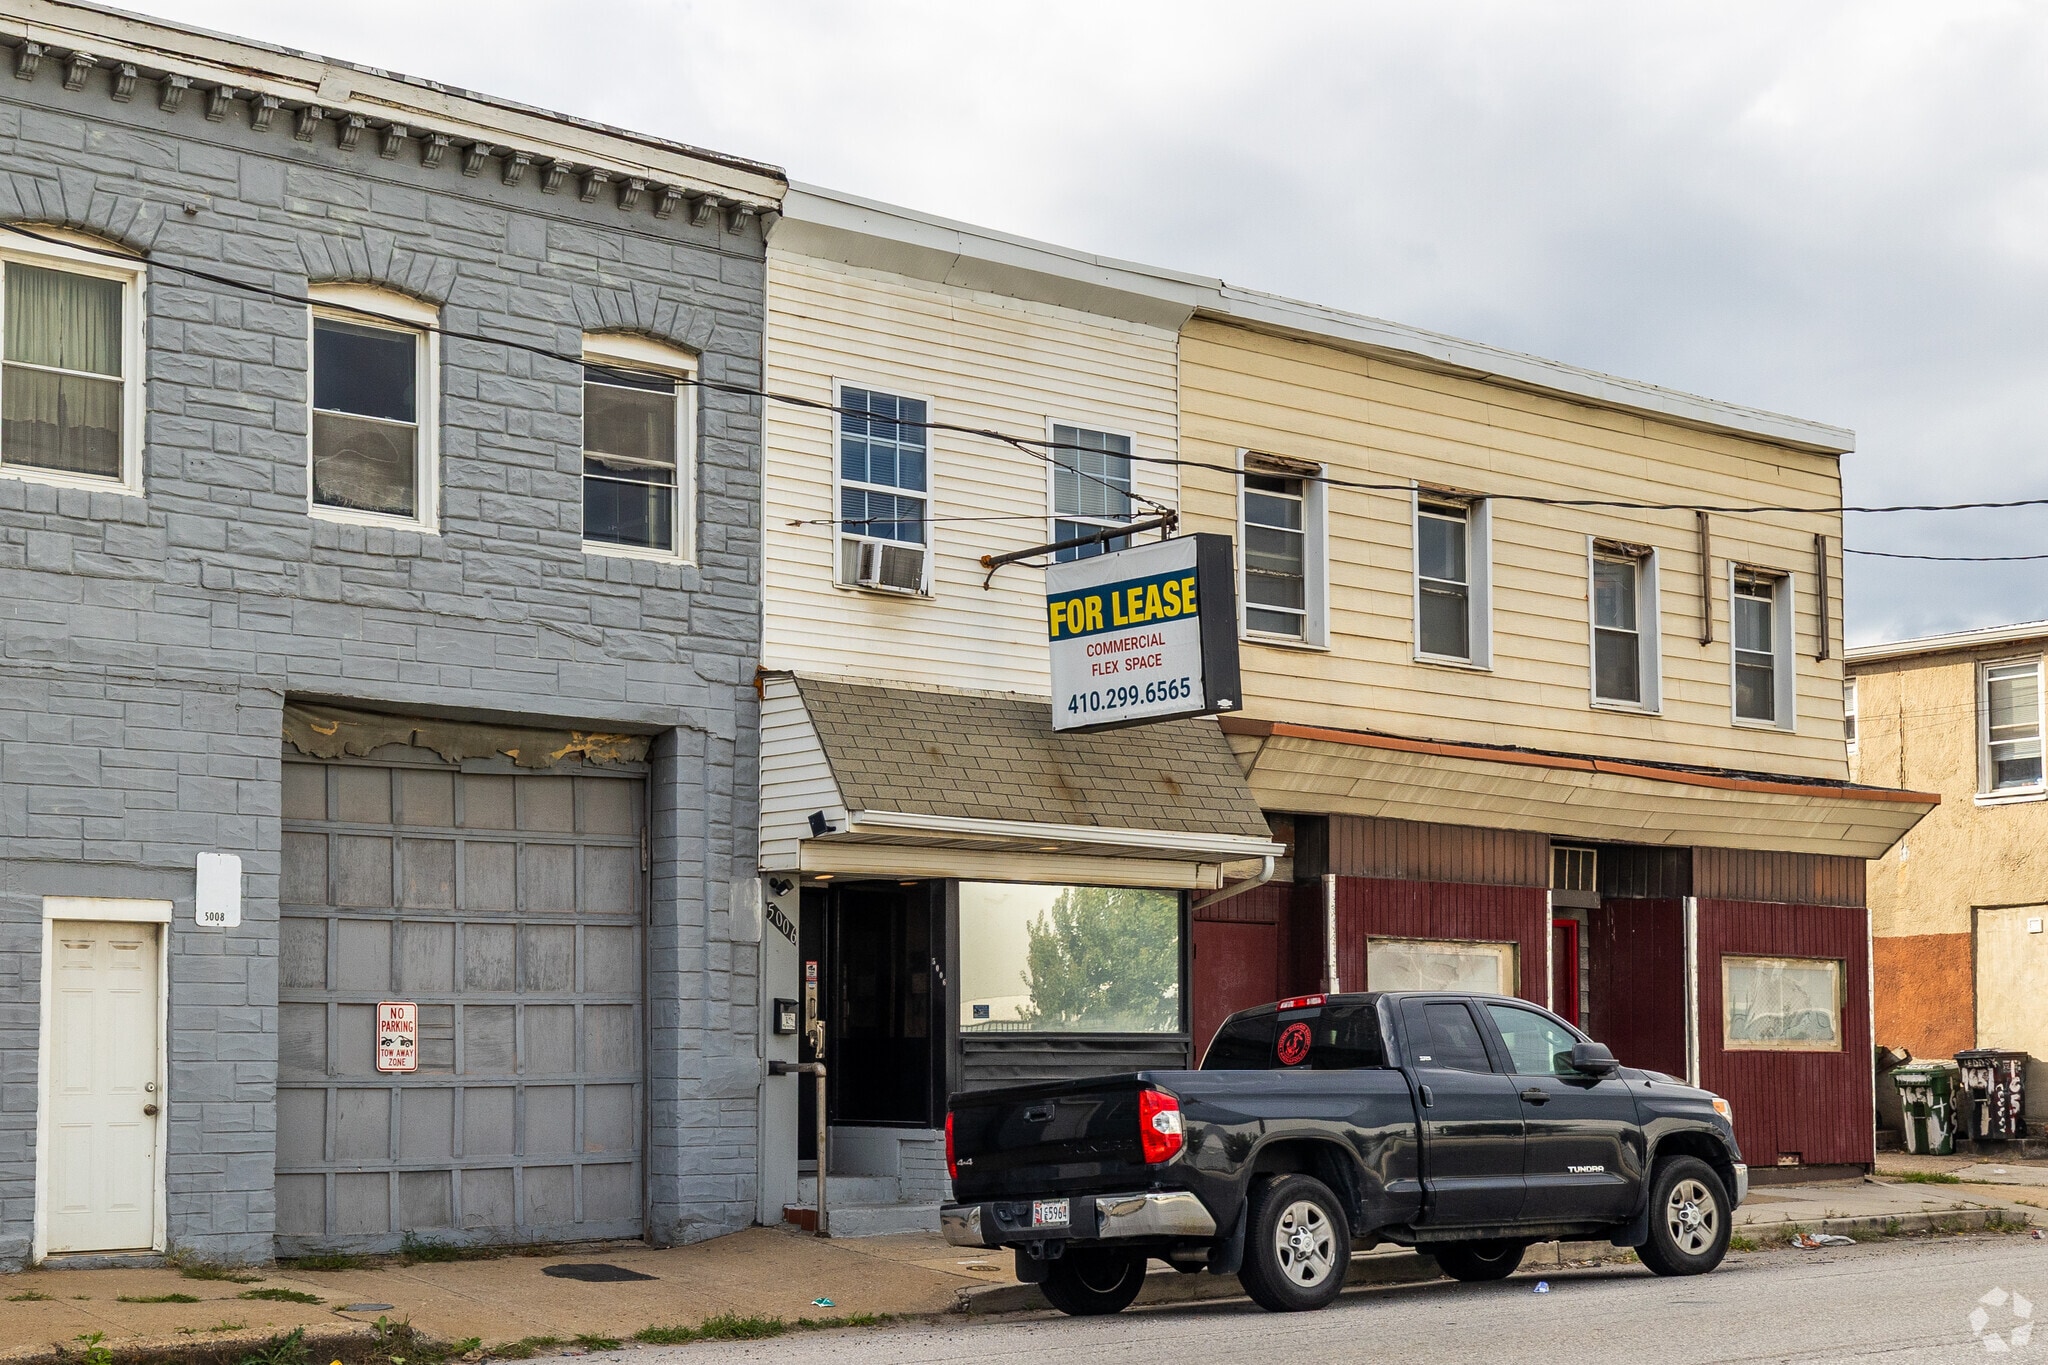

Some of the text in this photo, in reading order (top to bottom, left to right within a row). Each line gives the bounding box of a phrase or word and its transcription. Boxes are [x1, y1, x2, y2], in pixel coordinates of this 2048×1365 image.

[1050, 576, 1197, 637] FOR LEASE
[1086, 632, 1166, 657] COMMERCIAL
[1091, 653, 1163, 677] FLEX SPACE
[1068, 677, 1191, 714] 410.299.6565
[204, 911, 225, 922] 5008
[768, 903, 797, 944] 5006
[390, 1007, 405, 1020] NO
[381, 1020, 414, 1033] PARKING
[381, 1048, 414, 1057] TOW AWAY
[388, 1057, 406, 1067] ZONE
[1567, 1165, 1605, 1173] TUNDRA
